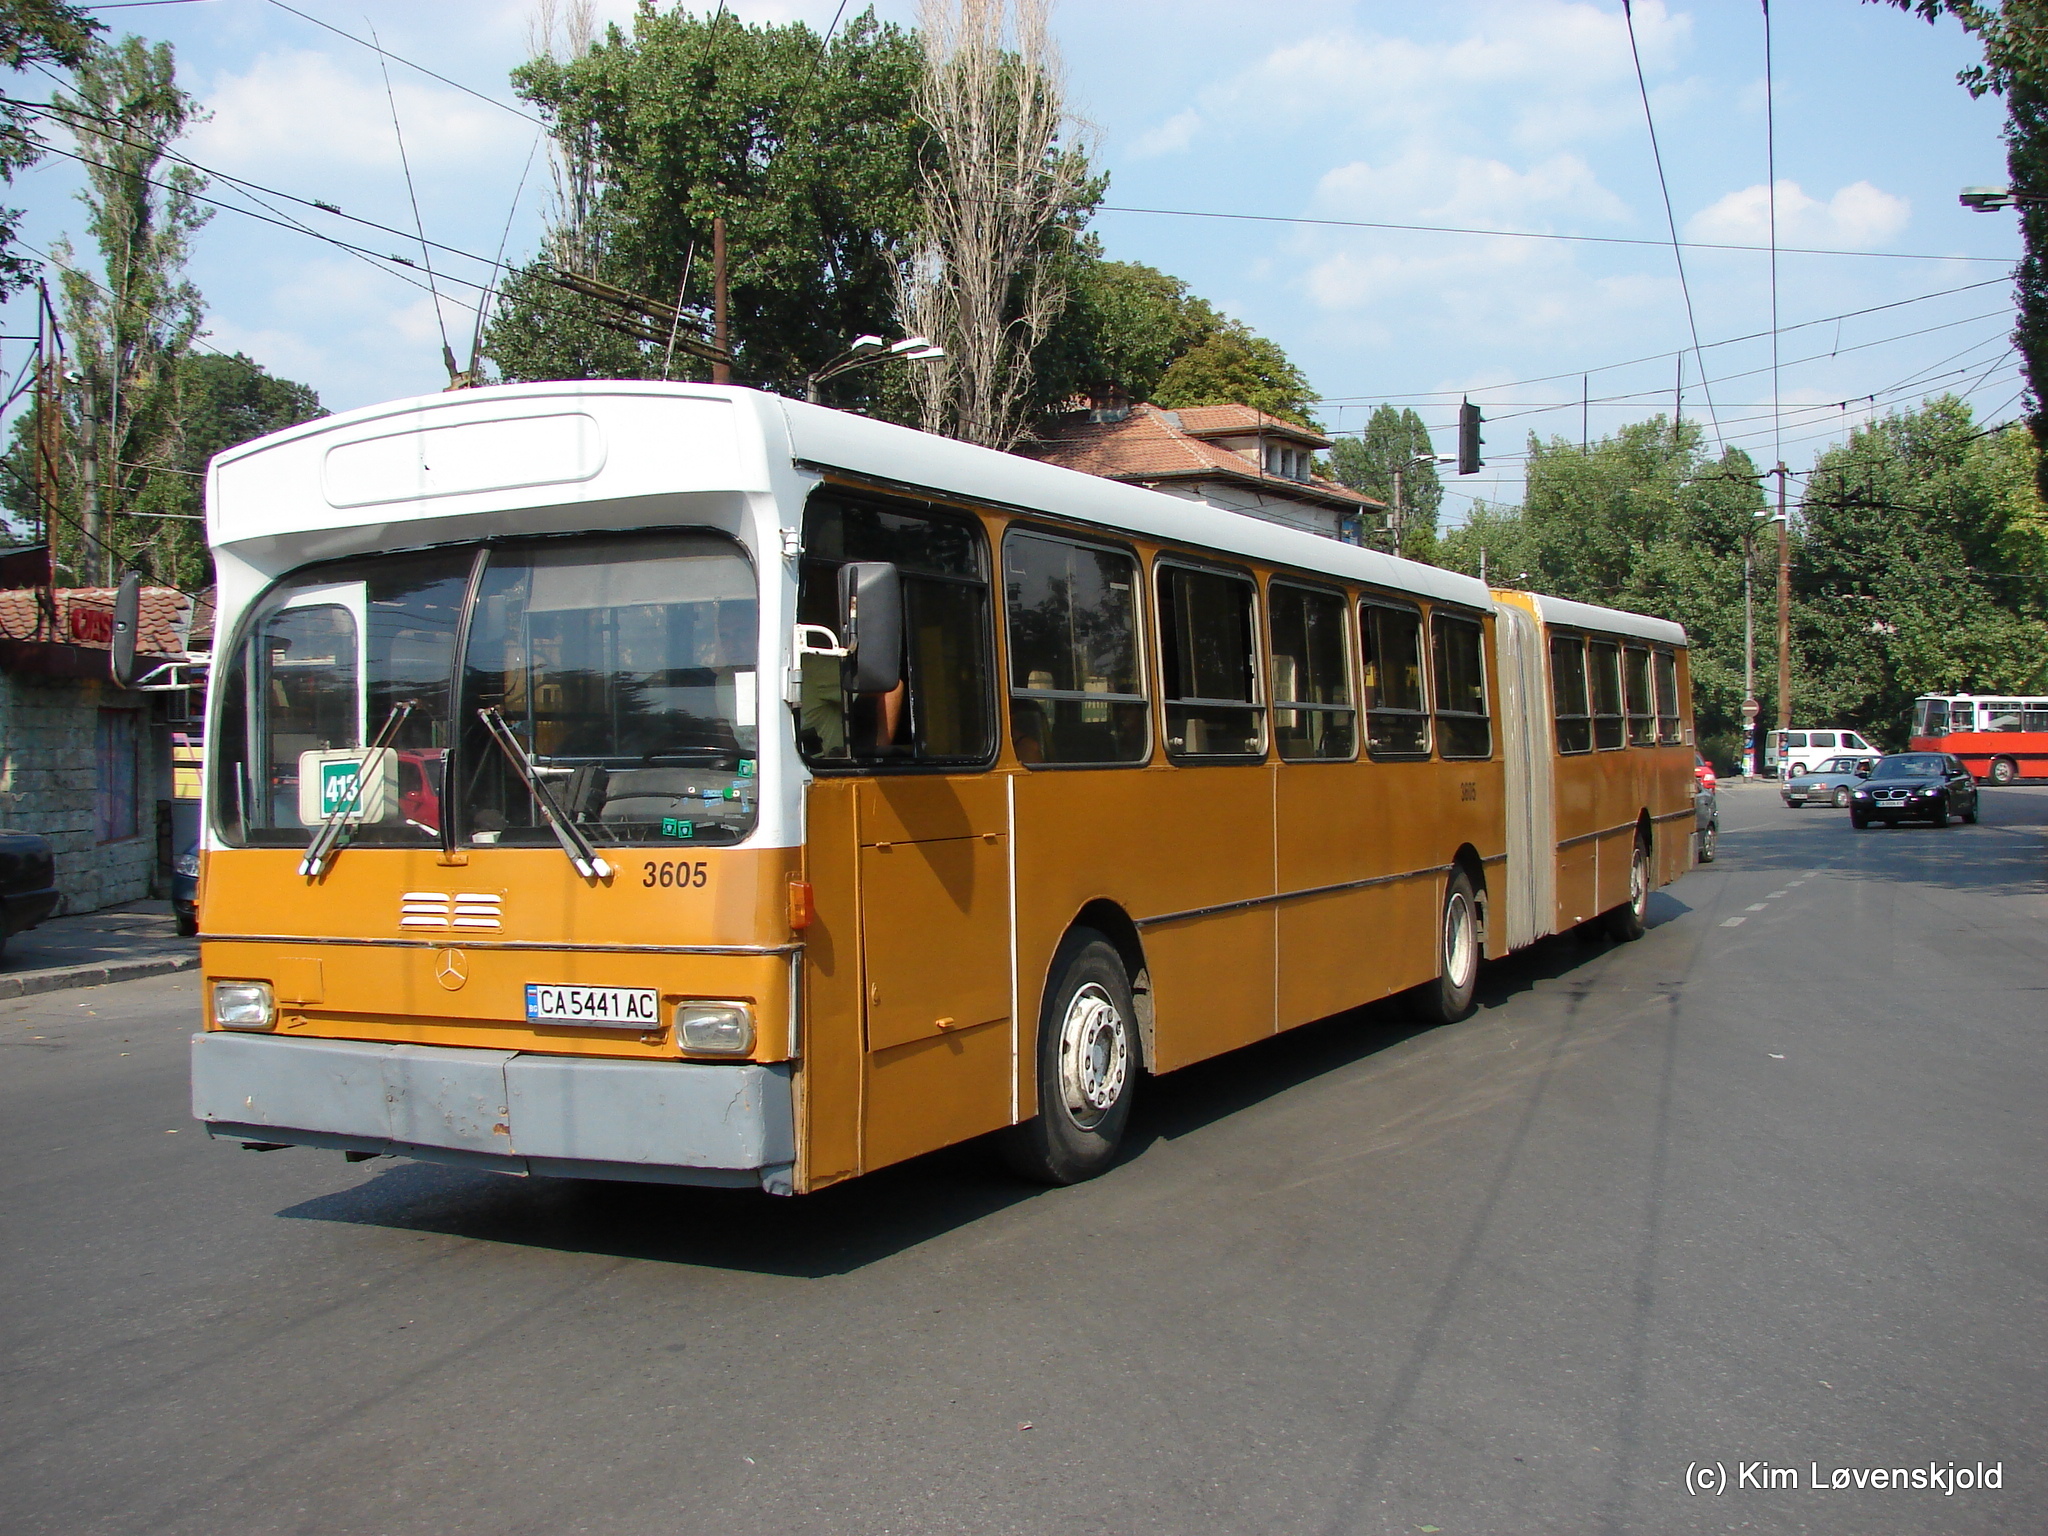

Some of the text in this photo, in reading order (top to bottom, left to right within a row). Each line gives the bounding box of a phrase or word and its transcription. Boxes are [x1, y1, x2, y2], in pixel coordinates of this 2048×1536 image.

[71, 607, 114, 643] CAS
[326, 775, 359, 802] 413
[642, 861, 708, 888] 3605
